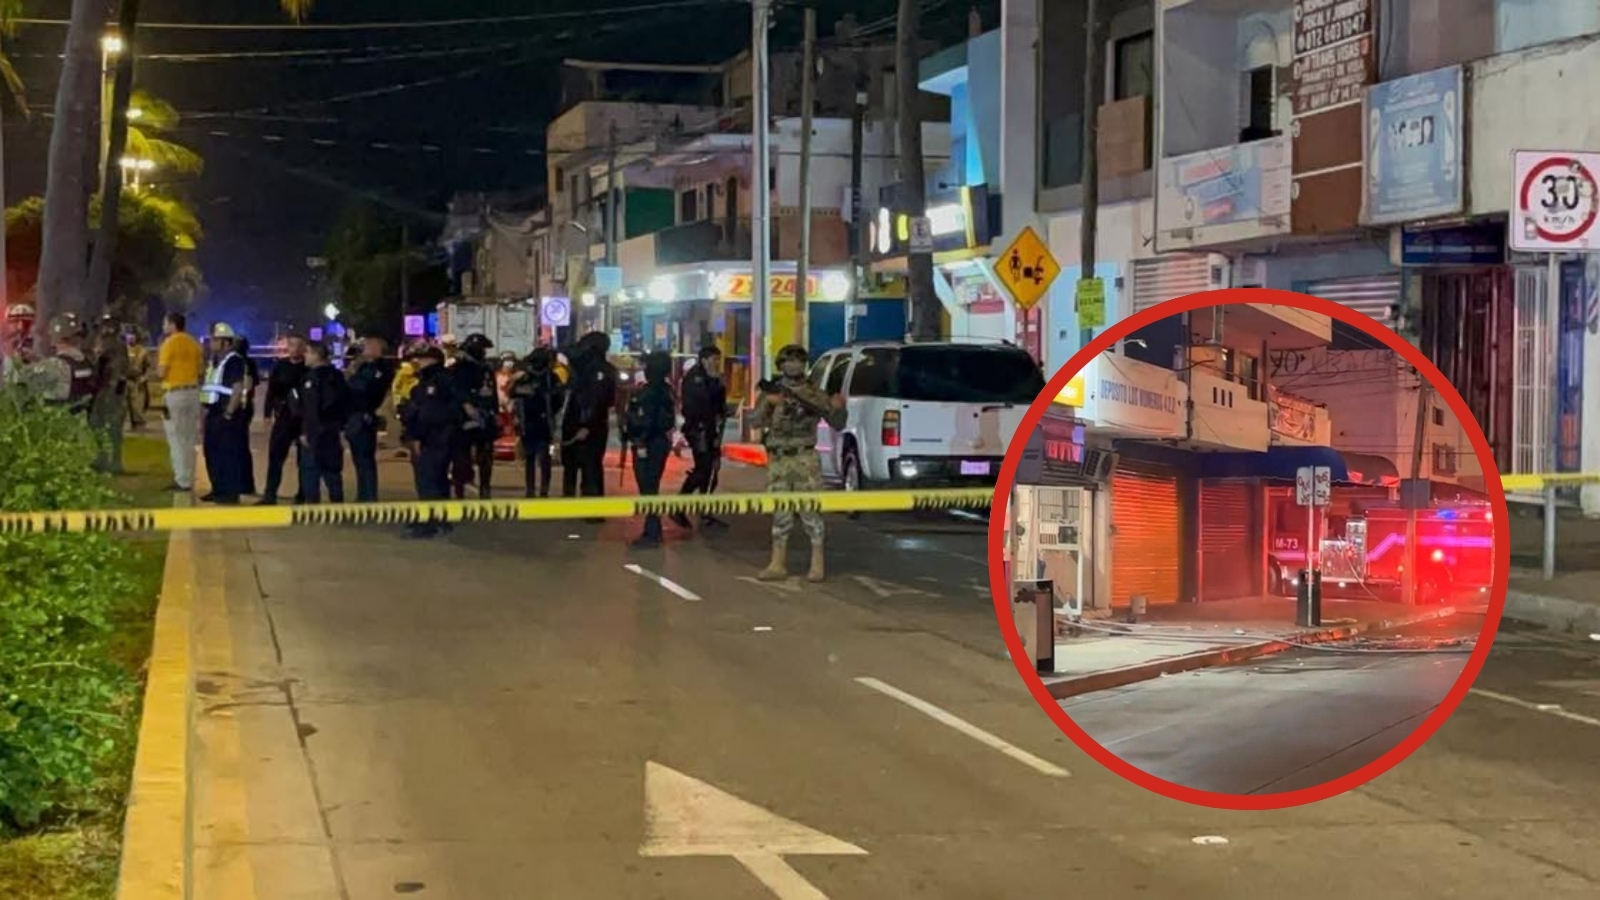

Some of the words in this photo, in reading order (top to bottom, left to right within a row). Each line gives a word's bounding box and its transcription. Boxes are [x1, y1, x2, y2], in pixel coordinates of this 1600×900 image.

[1541, 174, 1579, 210] 30
[1543, 215, 1575, 224] km/h
[1275, 537, 1299, 550] M-73
